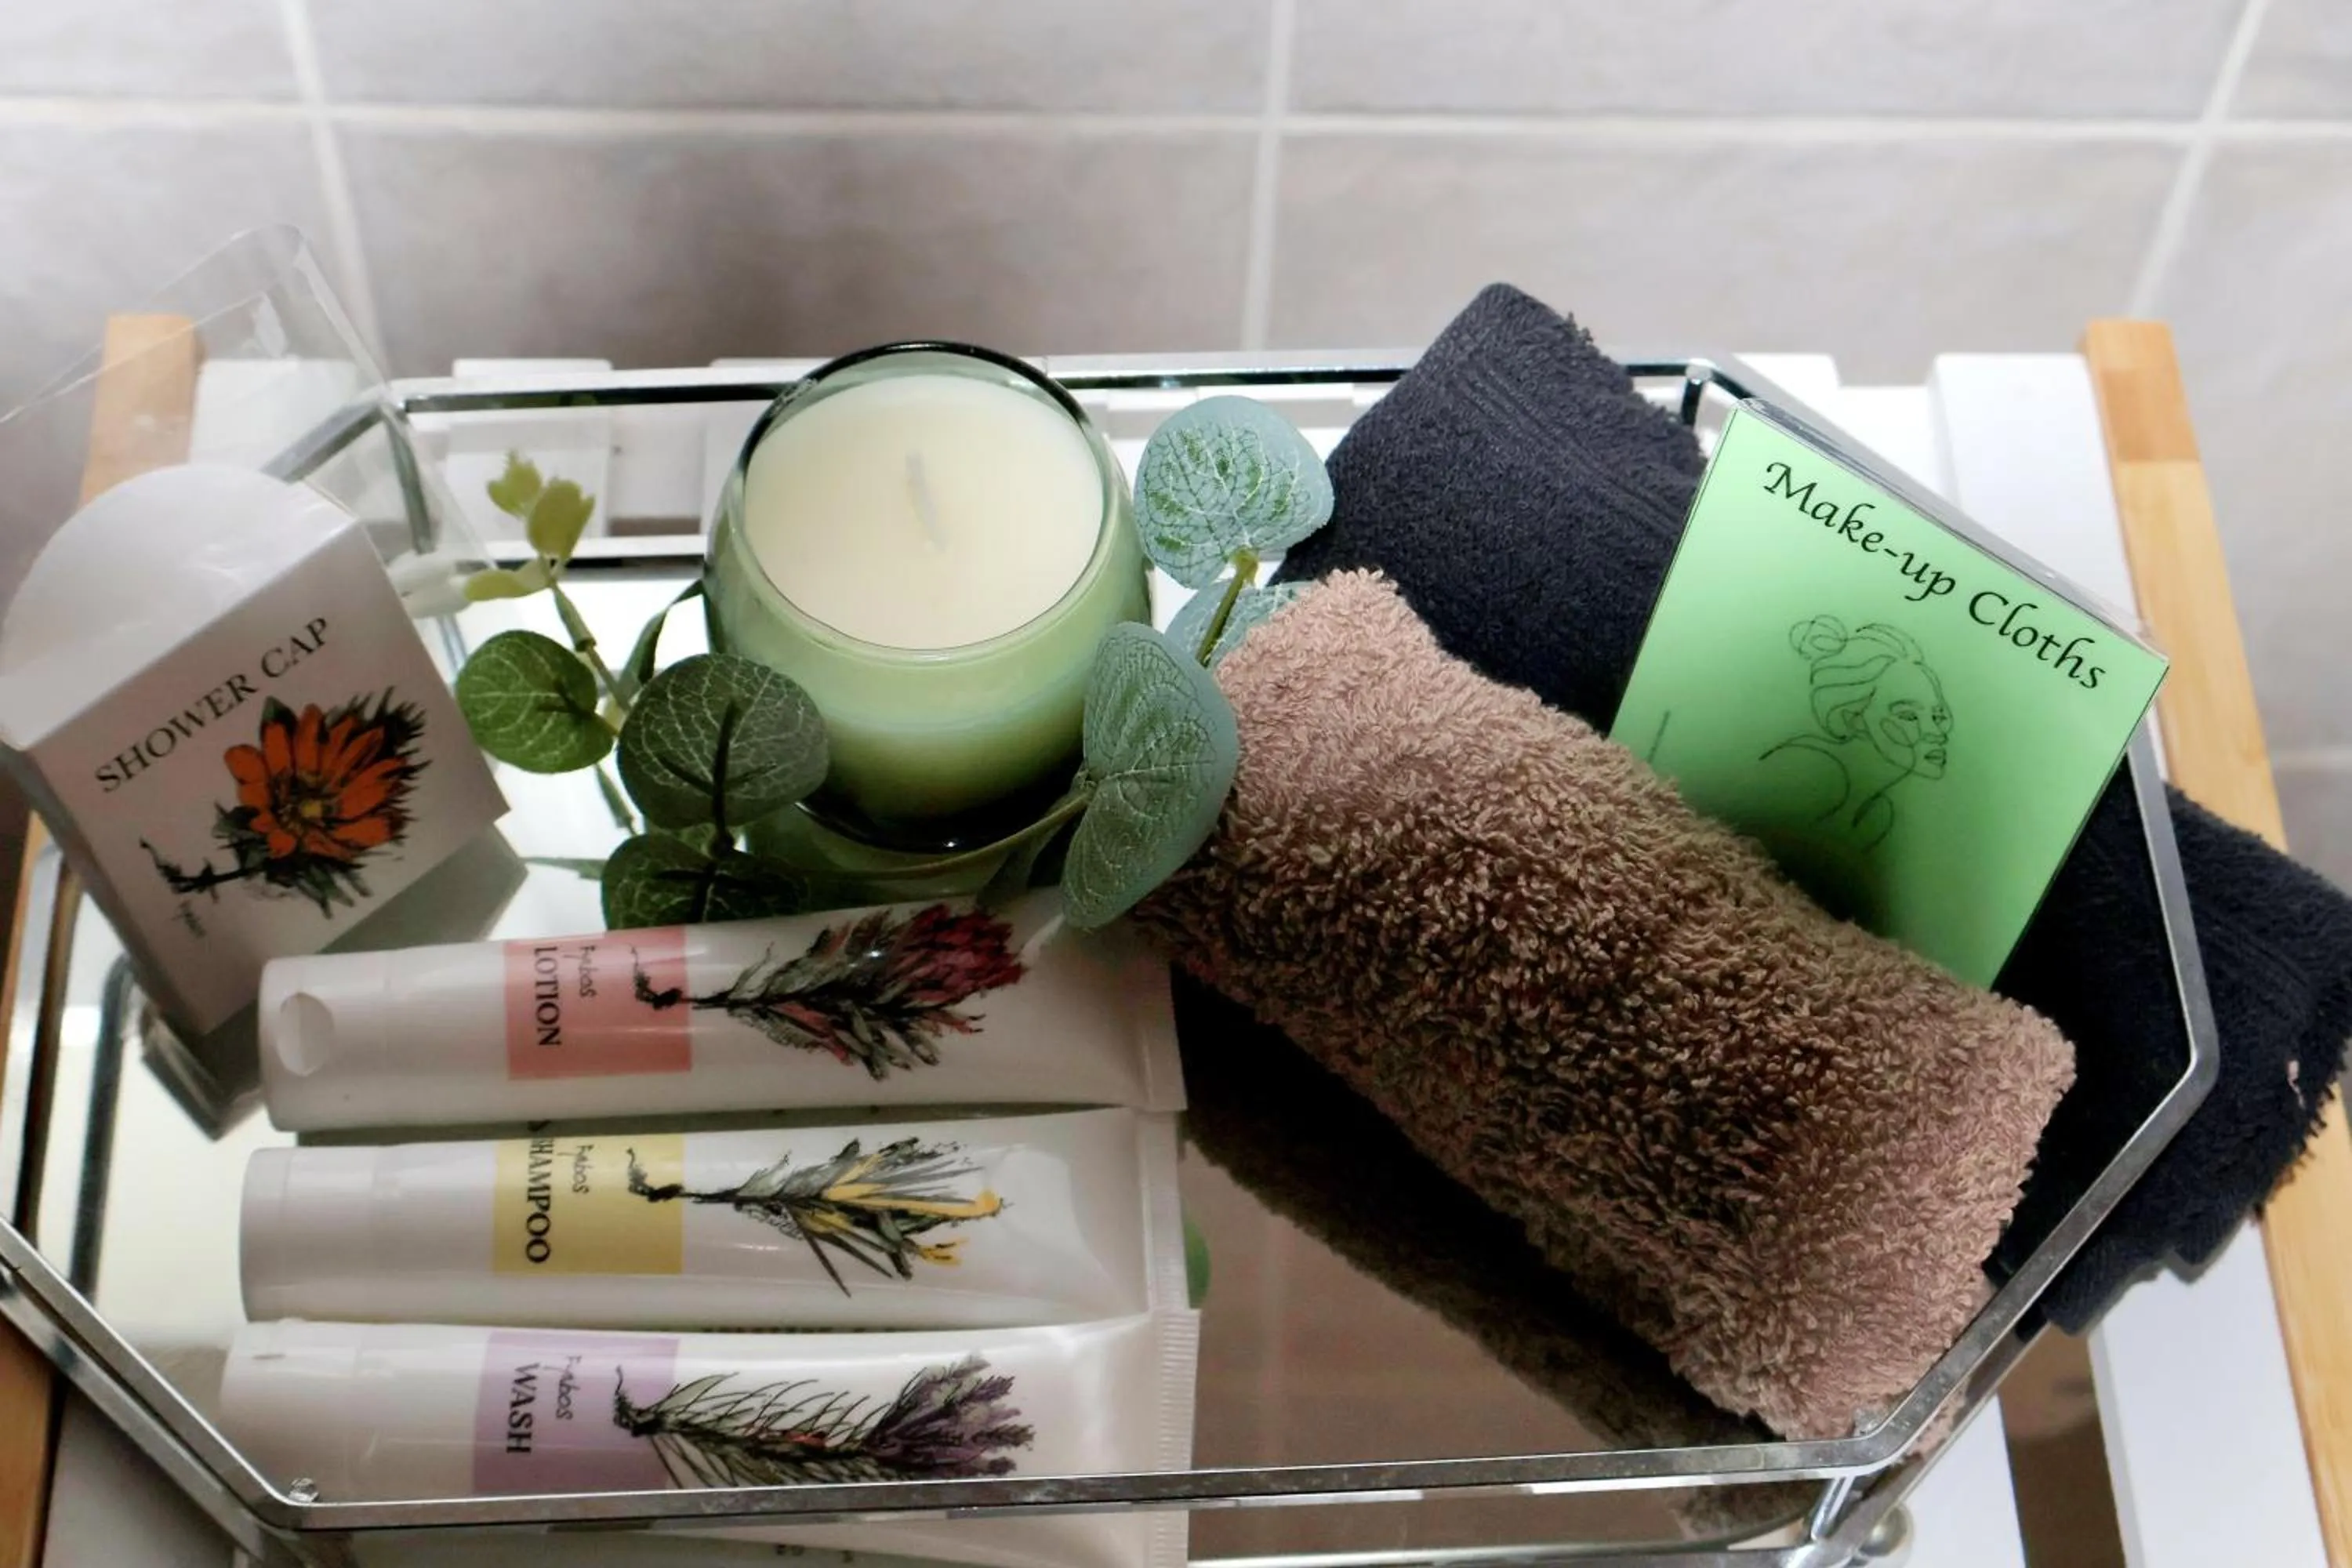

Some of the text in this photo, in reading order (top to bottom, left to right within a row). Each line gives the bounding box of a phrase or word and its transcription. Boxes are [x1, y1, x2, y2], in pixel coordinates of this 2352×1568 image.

[1762, 461, 2107, 691] Make-up Cloths
[93, 615, 329, 793] SHOWER CAP
[533, 946, 562, 1047] LOTION
[505, 1361, 541, 1454] WASH
